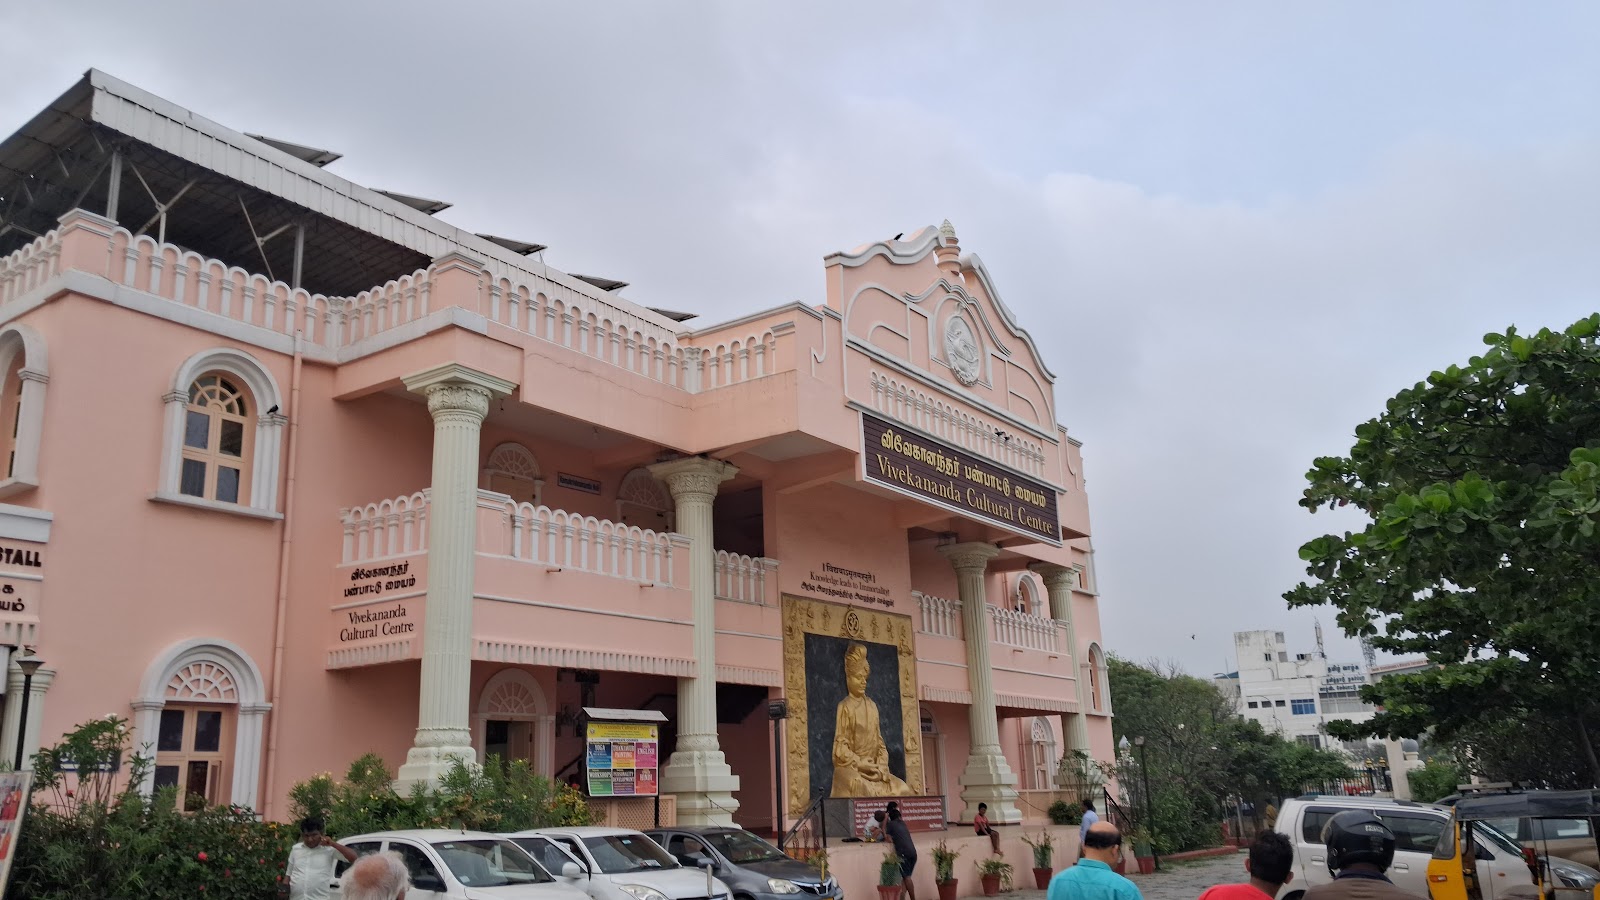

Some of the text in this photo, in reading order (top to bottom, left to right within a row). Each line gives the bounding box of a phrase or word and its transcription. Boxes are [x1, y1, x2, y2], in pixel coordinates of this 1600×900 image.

[881, 428, 1047, 509] விவேகானந்தர் பண்பாட்டு மையம்
[876, 453, 1053, 535] Vivekananda Cultural Centre
[351, 560, 410, 581] விவேகானந்தர்
[810, 571, 839, 587] Knowledge
[839, 577, 852, 588] leads
[852, 581, 859, 589] to
[344, 574, 416, 598] பண்பாட்டு மையம்
[348, 604, 407, 625] Vivekananda
[340, 621, 414, 642] Cultural Centre
